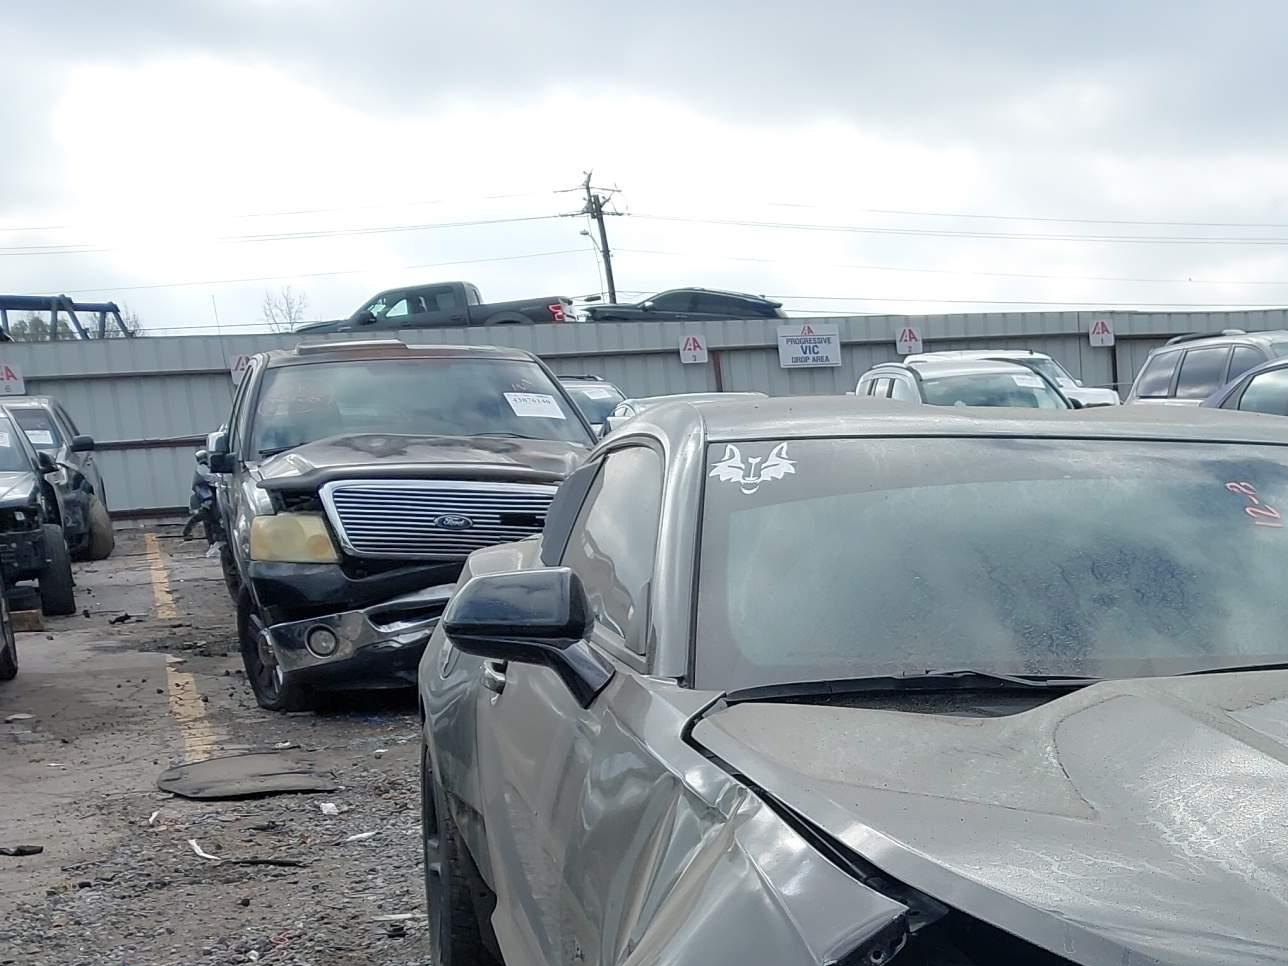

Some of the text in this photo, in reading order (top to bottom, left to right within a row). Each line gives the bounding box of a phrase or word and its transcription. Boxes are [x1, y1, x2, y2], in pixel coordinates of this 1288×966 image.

[785, 336, 833, 345] PROGRESSIVE
[800, 344, 820, 355] VIC
[791, 355, 831, 364] DROP AREA
